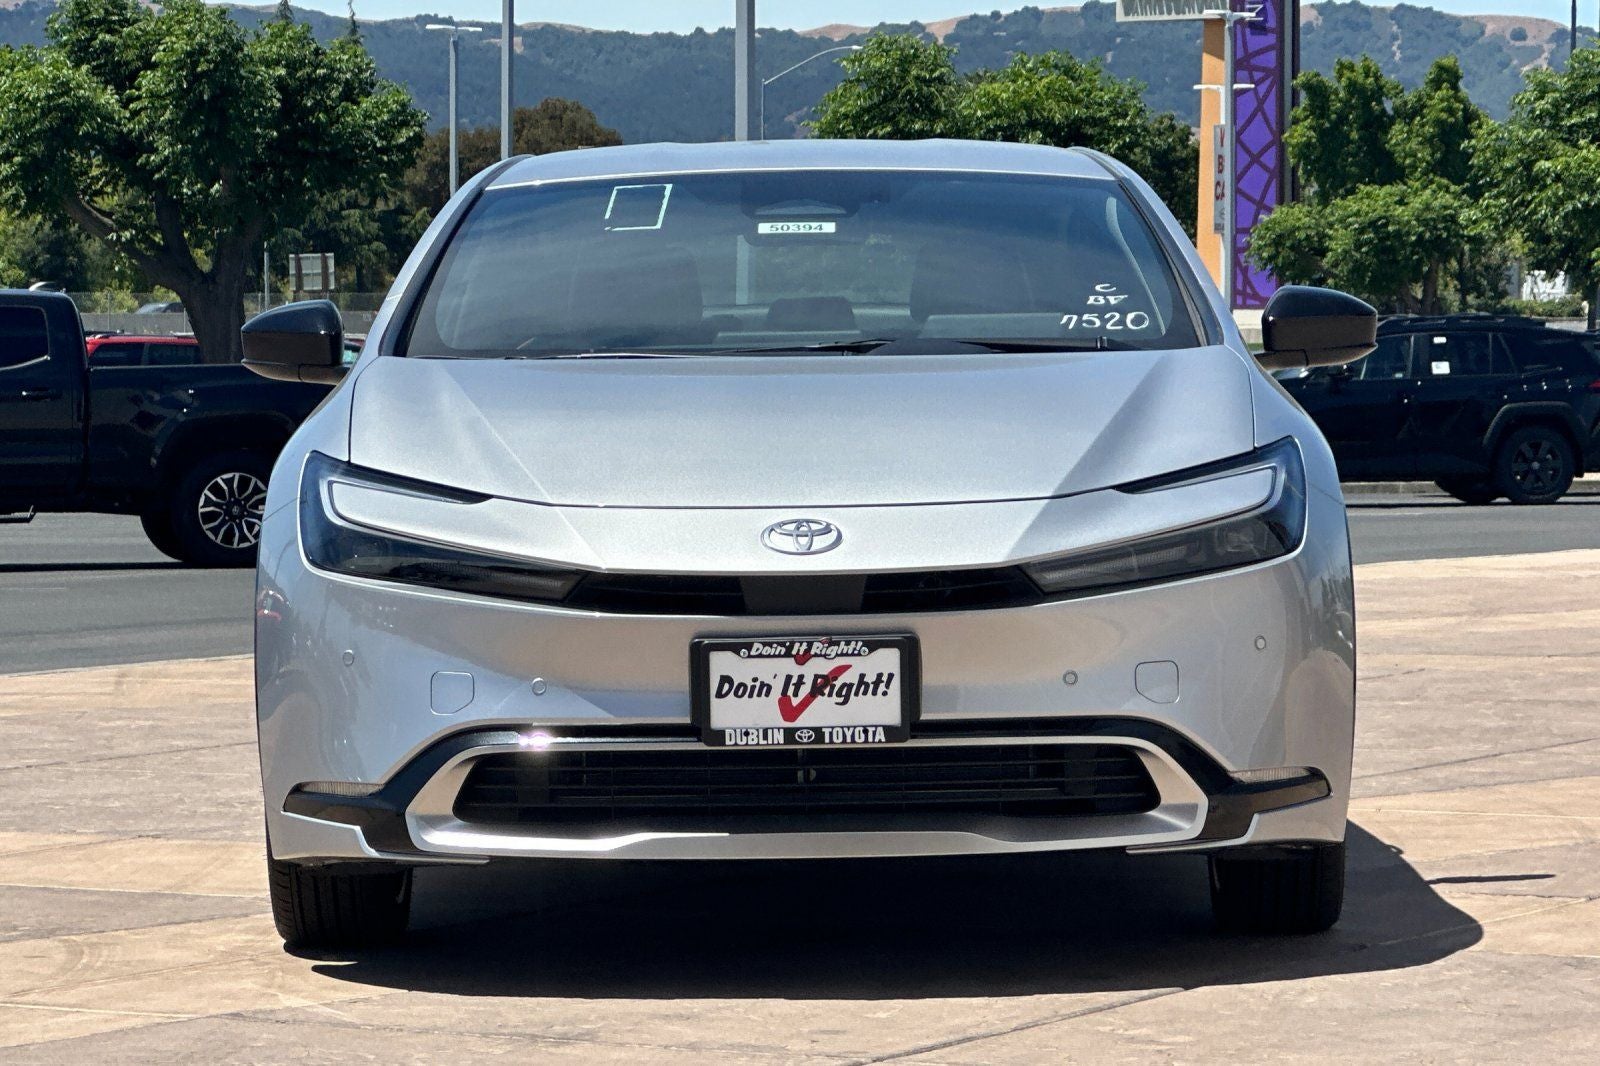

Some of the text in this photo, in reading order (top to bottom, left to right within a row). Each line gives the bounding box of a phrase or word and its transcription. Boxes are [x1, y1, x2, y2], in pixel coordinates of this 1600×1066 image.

[769, 224, 824, 232] 50394
[1060, 311, 1150, 330] 7520
[750, 640, 863, 659] Doin' It Right!
[714, 672, 895, 706] Doin' It Right!
[724, 726, 887, 746] DUBLIN TOYOTA
